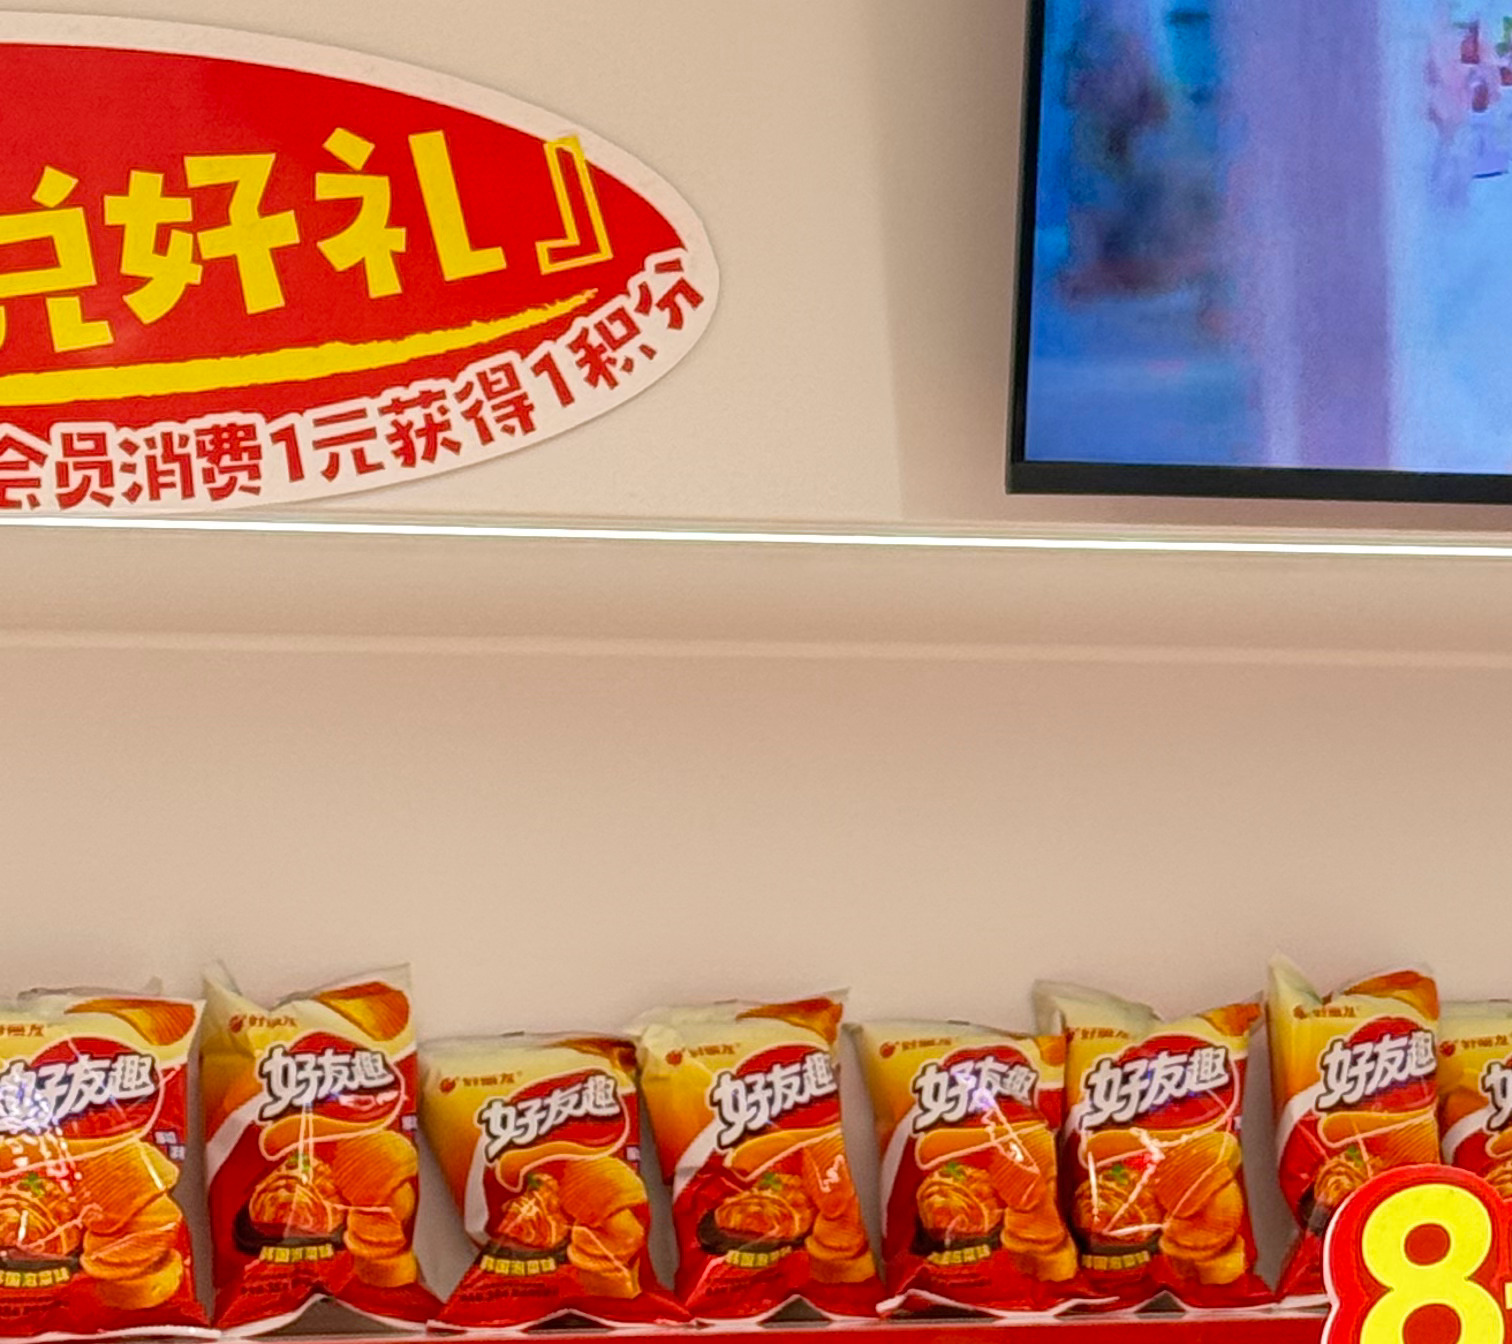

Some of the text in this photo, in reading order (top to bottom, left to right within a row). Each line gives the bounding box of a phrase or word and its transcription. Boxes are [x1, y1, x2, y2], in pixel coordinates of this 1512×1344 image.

[260, 1046, 395, 1120] 好友趣
[712, 1049, 836, 1148] 好友趣
[914, 1056, 1039, 1130] 好友趣
[1081, 1047, 1230, 1129] 好友趣
[1316, 1030, 1438, 1111] 好友趣
[479, 1074, 621, 1159] 好友趣
